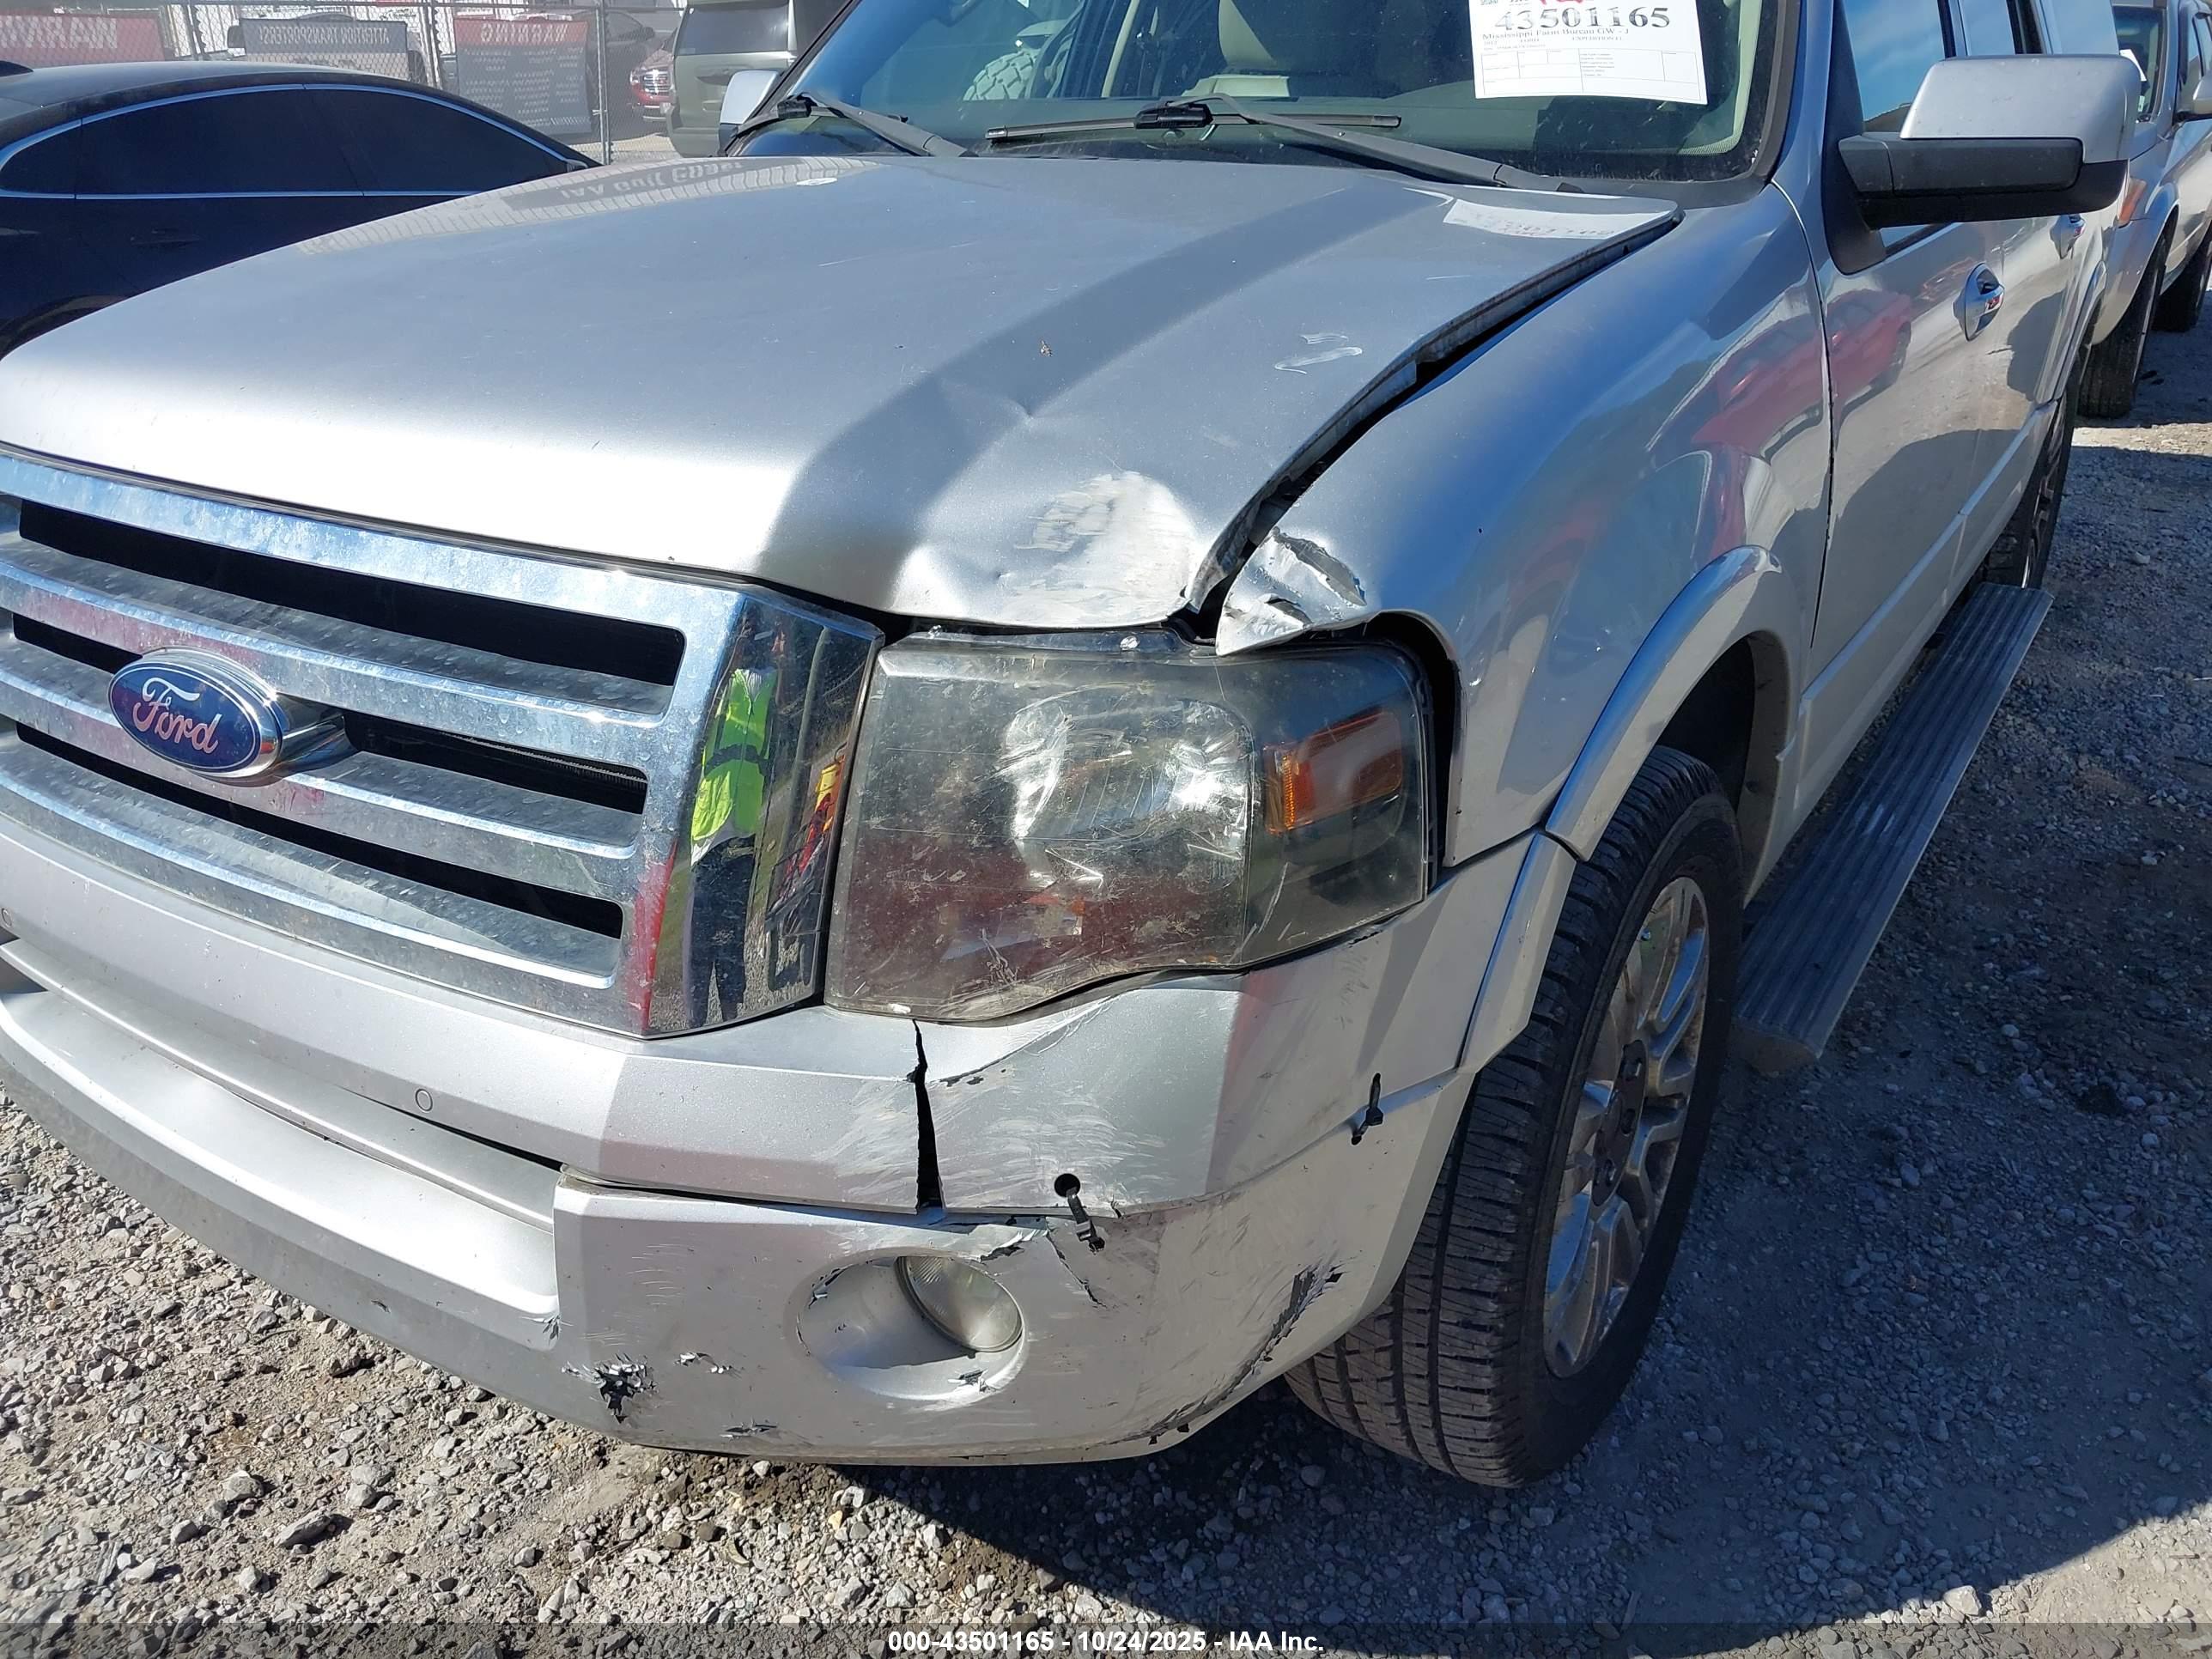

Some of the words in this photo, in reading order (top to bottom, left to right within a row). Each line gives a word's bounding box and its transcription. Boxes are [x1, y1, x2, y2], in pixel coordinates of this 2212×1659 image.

[1495, 7, 1670, 31] 43501165
[1482, 31, 1533, 40] Mississippi
[132, 677, 223, 754] Ford
